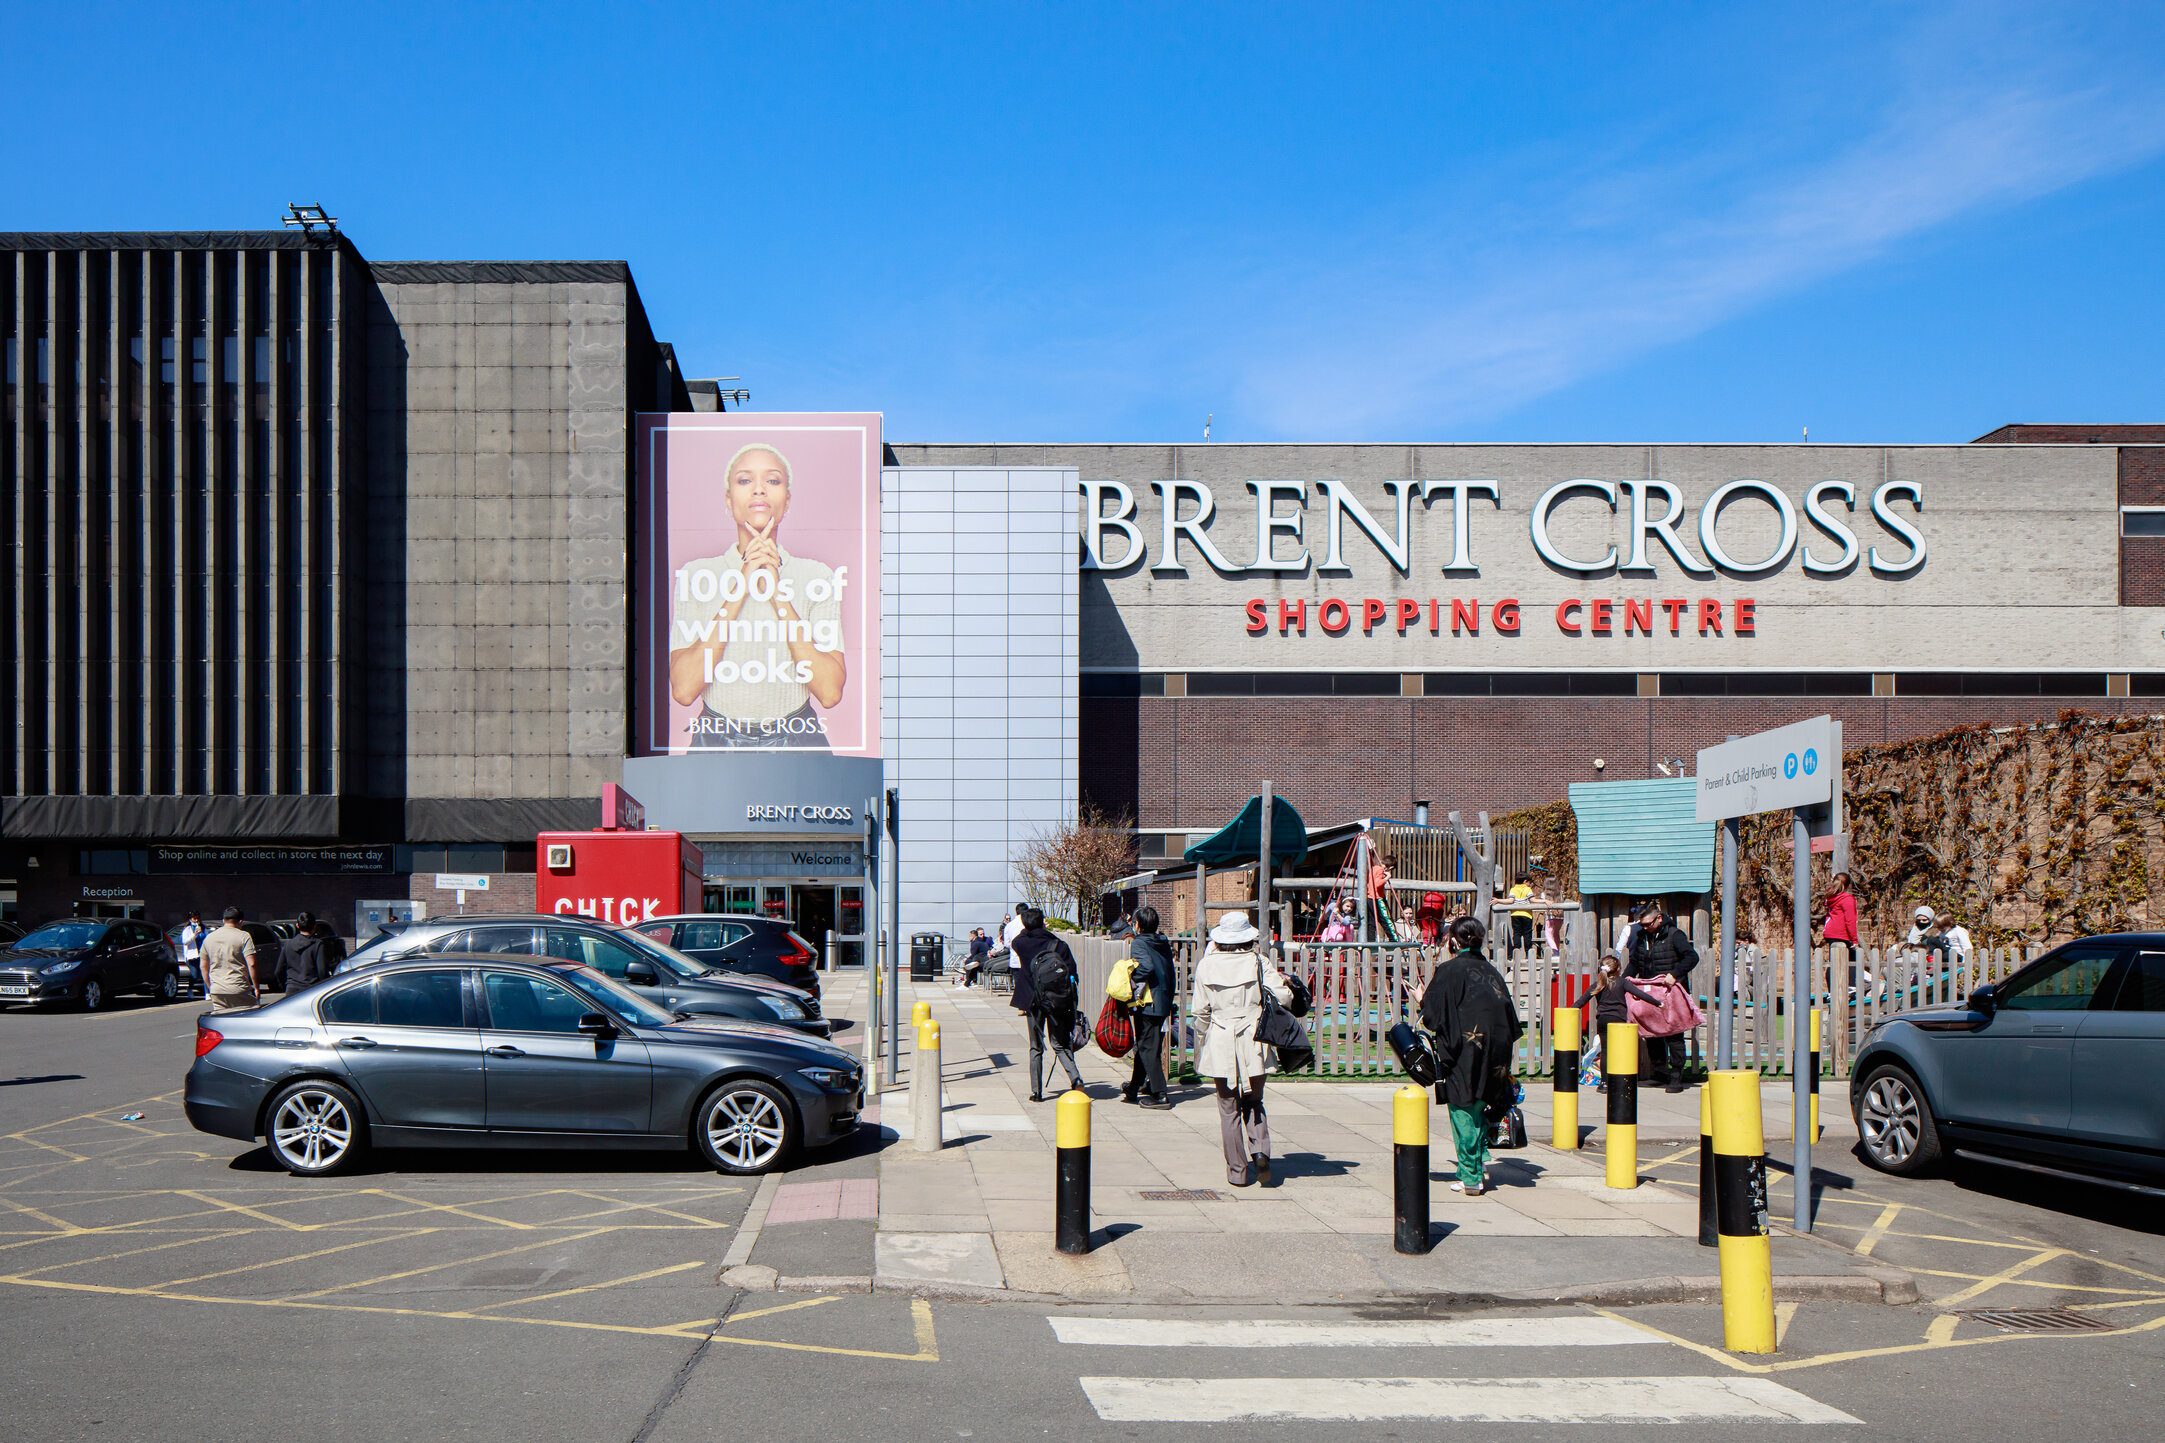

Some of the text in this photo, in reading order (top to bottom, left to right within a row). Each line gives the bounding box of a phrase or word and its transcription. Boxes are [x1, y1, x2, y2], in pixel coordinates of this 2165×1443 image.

[1079, 479, 1928, 577] BRENT CROSS
[675, 566, 848, 602] 1000s of
[1246, 599, 1756, 633] SHOPPING CENTRE
[676, 608, 838, 653] winning
[704, 648, 814, 684] looks
[689, 717, 828, 734] BRENT CROSS
[1704, 776, 1725, 791] Parent
[1725, 773, 1731, 786] &
[1732, 766, 1750, 784] Child
[1751, 763, 1777, 780] Parking
[746, 805, 852, 820] BRENT CROSS
[158, 849, 184, 862] Shop
[186, 849, 218, 860] online
[220, 849, 239, 860] and
[241, 849, 276, 860] collect
[278, 850, 288, 860] in
[290, 851, 318, 860] store
[320, 850, 337, 860] the
[339, 851, 363, 860] next
[791, 851, 852, 865] Welcome
[82, 886, 134, 899] Reception
